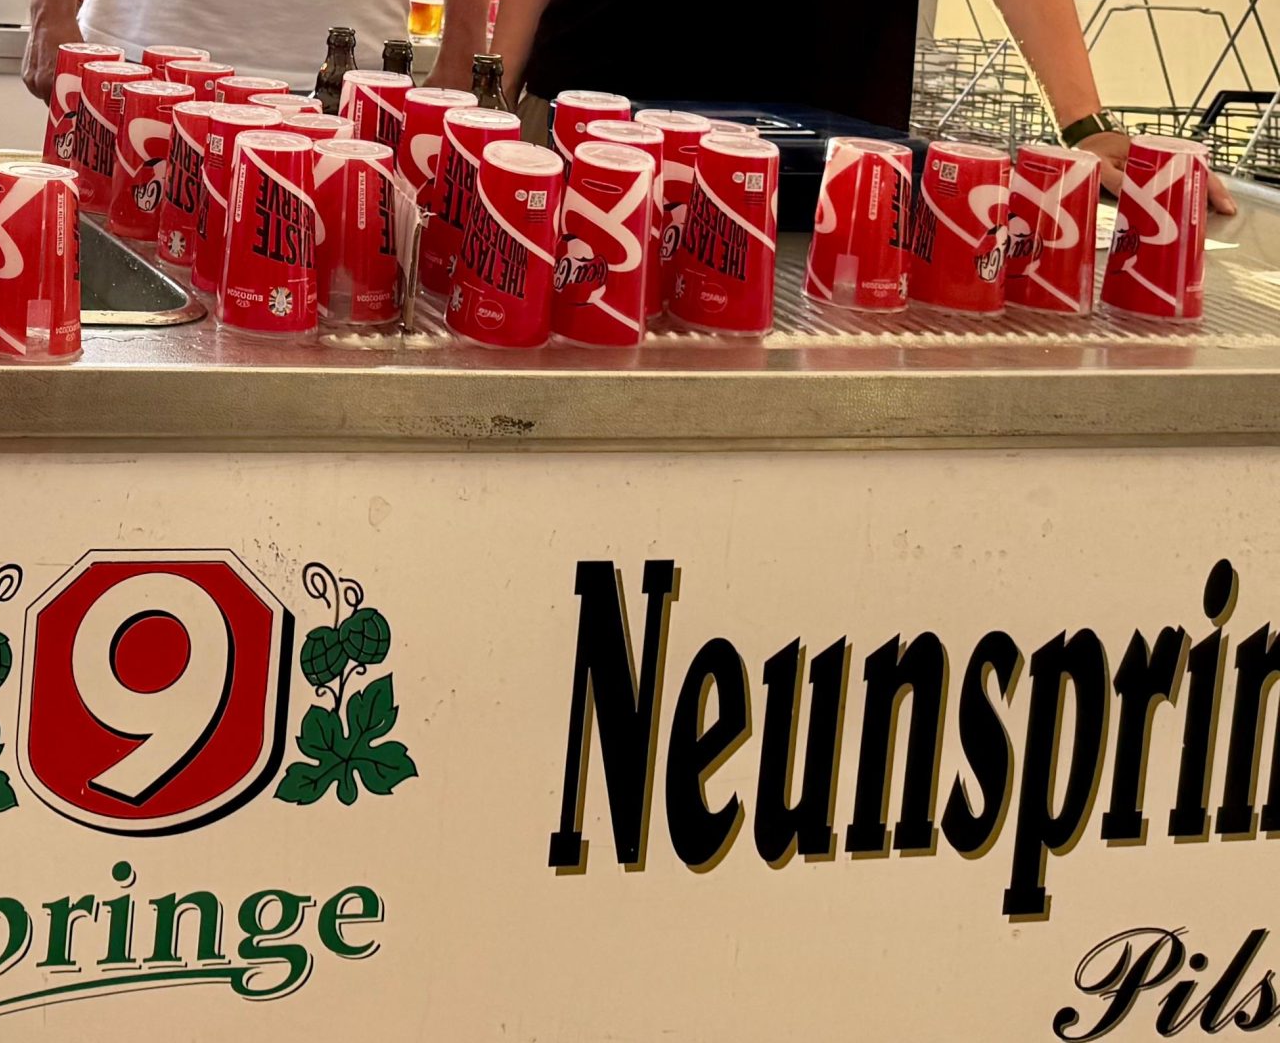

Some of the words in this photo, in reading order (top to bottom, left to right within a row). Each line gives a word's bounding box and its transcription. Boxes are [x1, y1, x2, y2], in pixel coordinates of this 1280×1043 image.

[169, 123, 203, 179] ERVE
[500, 257, 528, 300] THE
[721, 239, 748, 282] THE
[71, 571, 236, 807] 9
